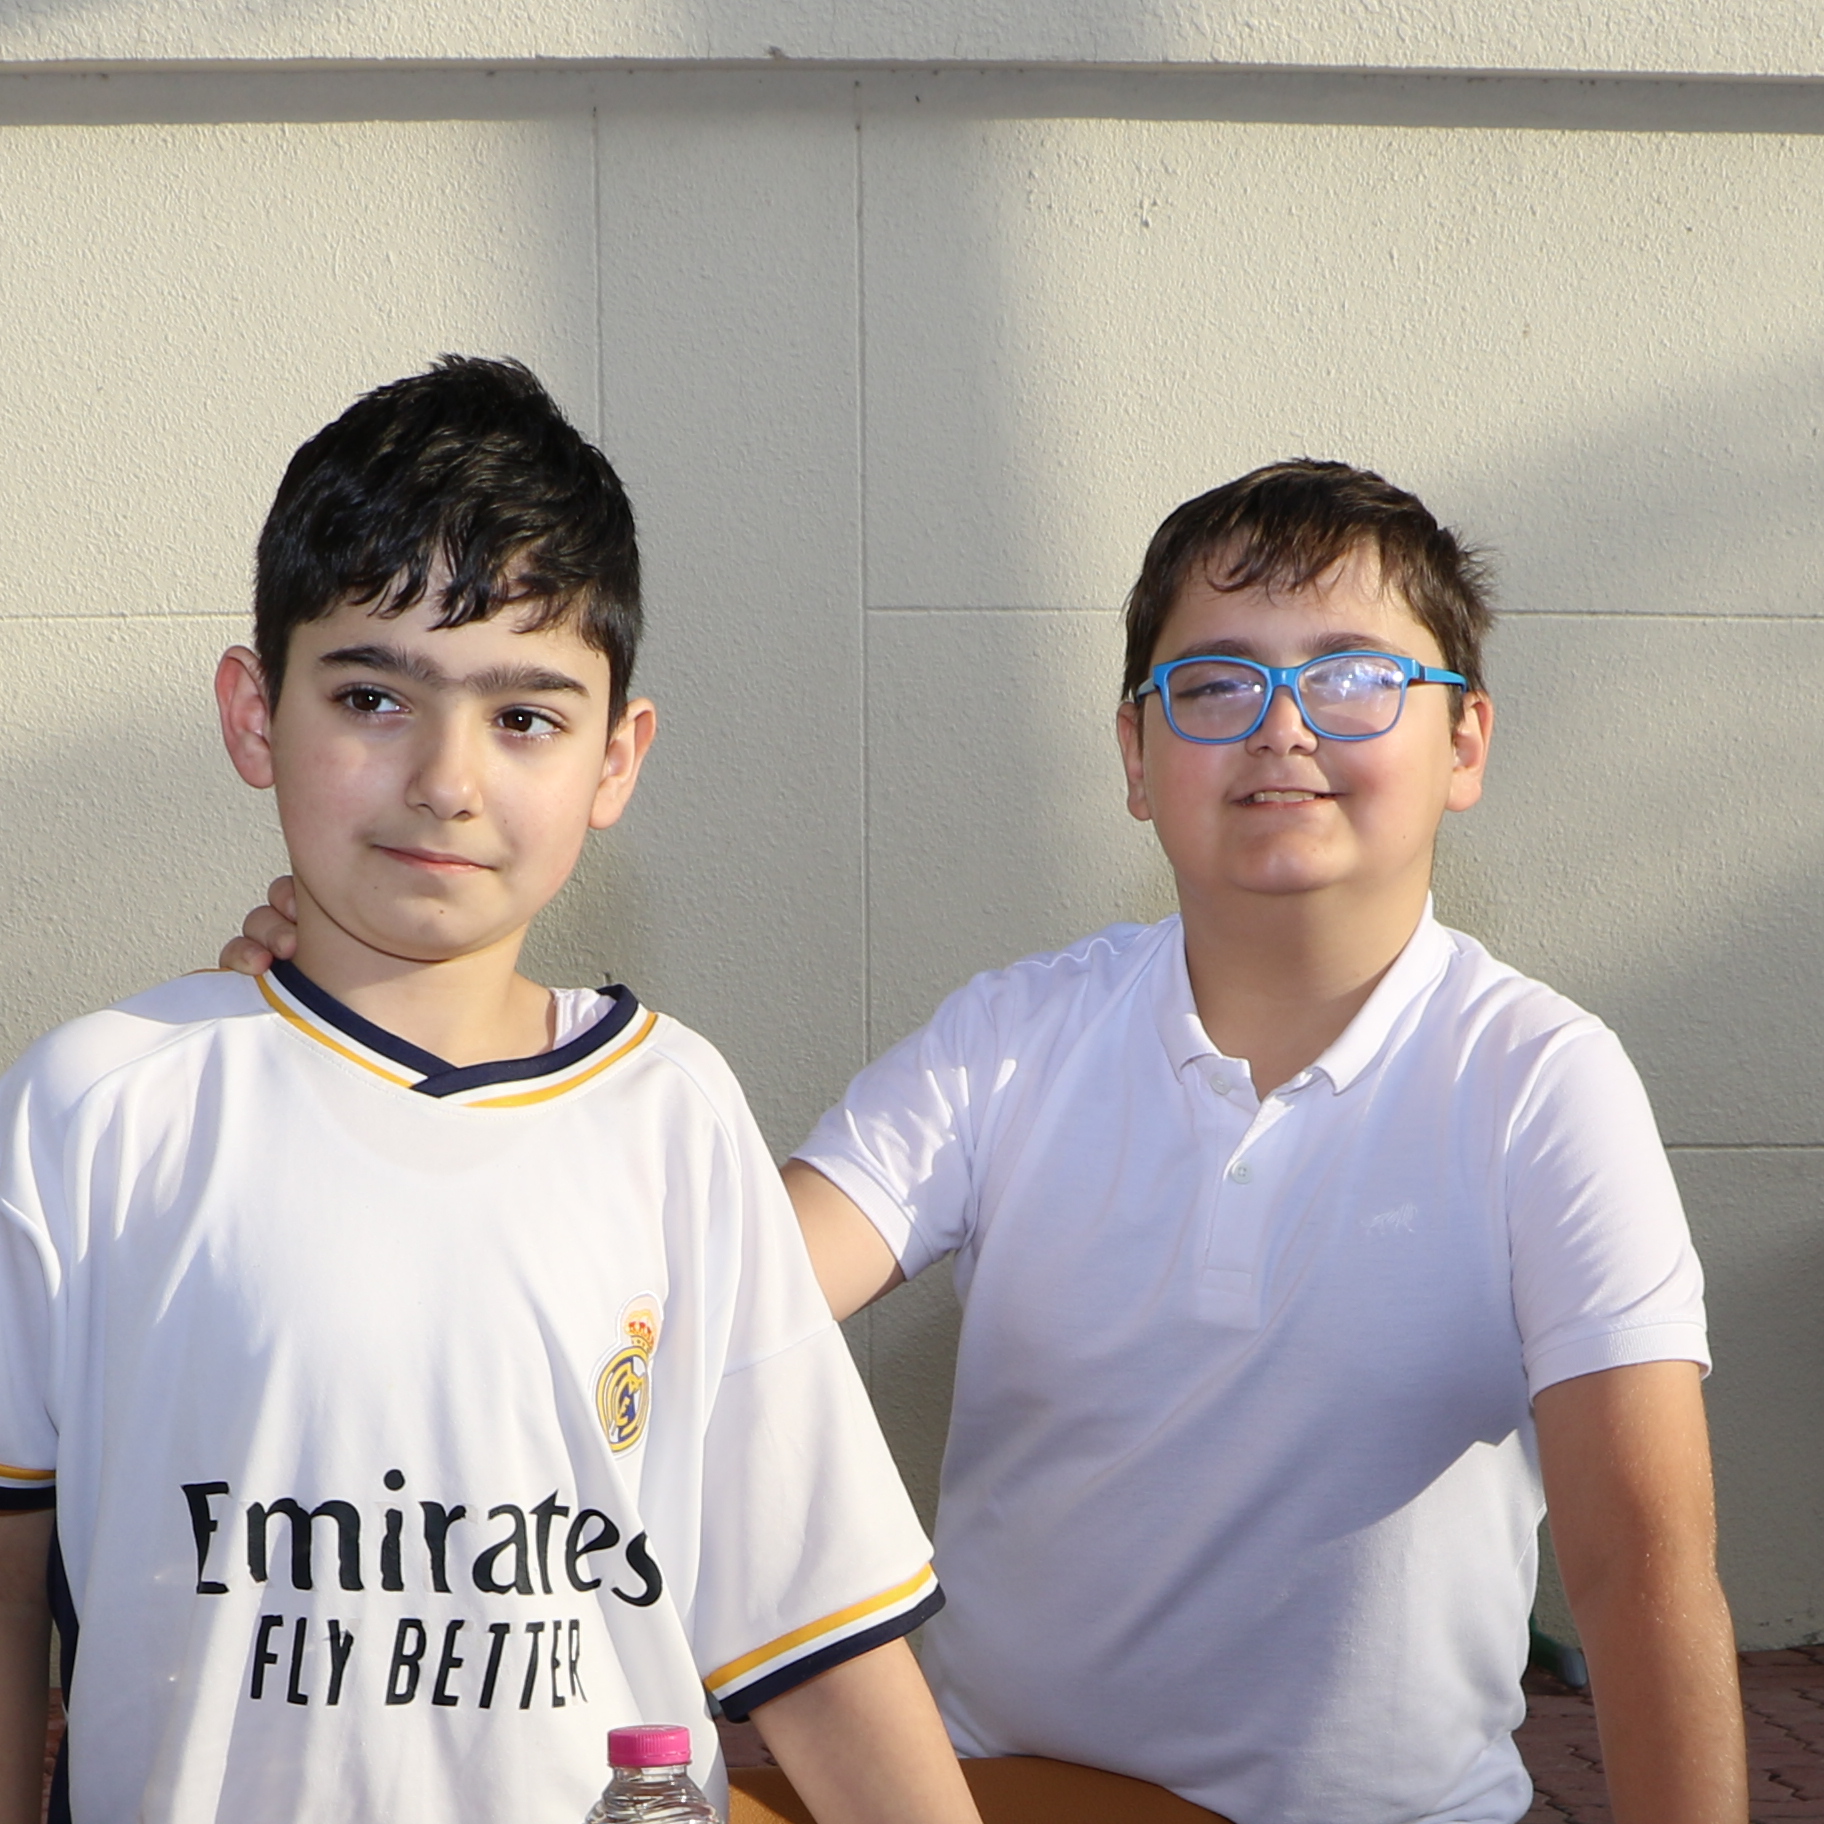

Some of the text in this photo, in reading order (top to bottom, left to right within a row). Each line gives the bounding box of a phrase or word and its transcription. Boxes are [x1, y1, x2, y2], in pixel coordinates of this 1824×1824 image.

[181, 1468, 663, 1607] Emirates
[249, 1613, 589, 1710] FLY BETTER
